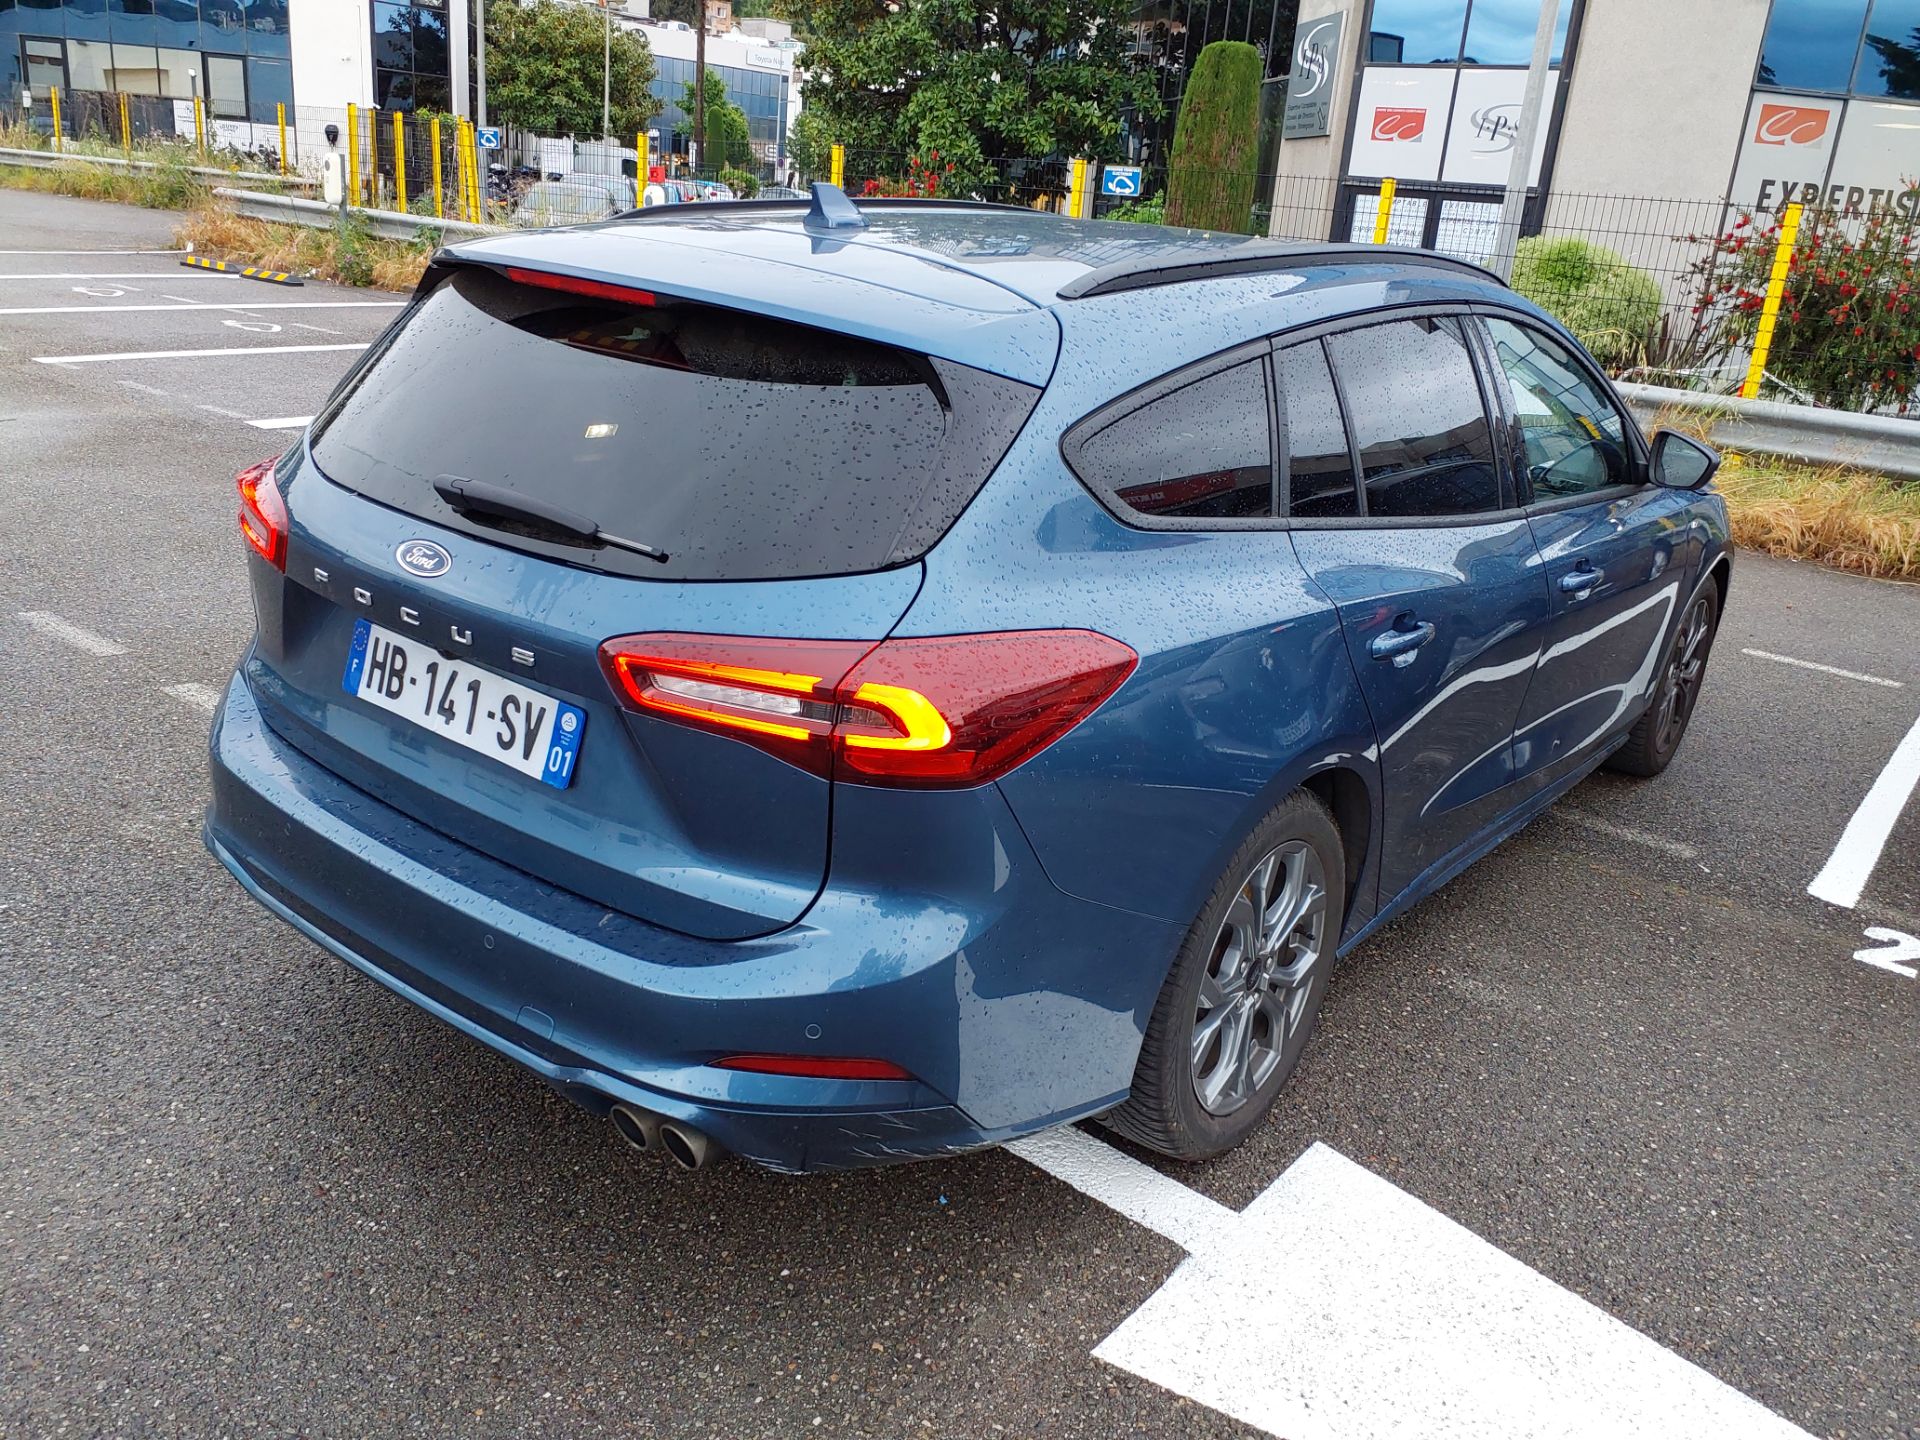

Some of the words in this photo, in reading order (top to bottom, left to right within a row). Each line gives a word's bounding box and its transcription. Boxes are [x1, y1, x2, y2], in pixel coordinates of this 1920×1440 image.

[1755, 179, 1920, 226] EXPERTIS
[405, 546, 440, 570] Ford
[314, 567, 535, 667] FOCUS
[351, 658, 359, 673] F
[366, 637, 547, 761] HB-141-SV
[548, 746, 572, 778] 01
[1853, 926, 1920, 979] 2
